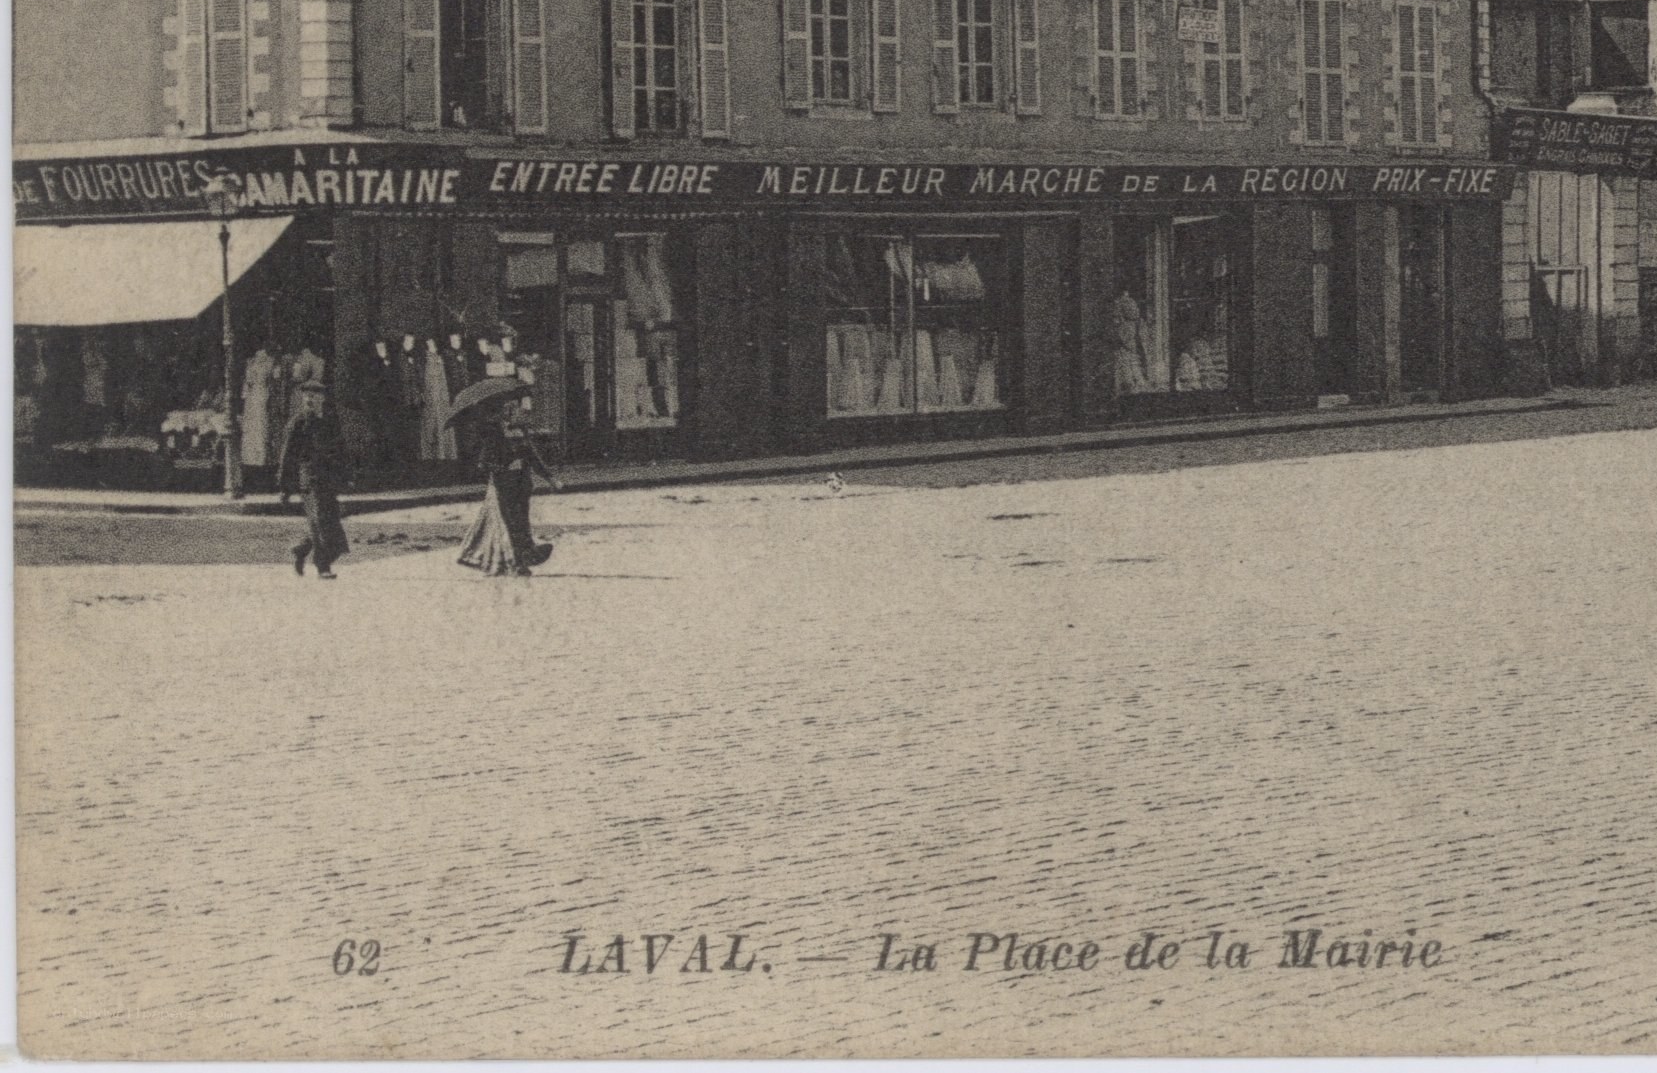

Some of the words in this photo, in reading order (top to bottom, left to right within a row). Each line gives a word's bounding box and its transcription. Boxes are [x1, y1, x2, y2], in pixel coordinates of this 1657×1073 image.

[329, 147, 360, 165] LA
[39, 160, 209, 203] FOURRURES
[489, 159, 620, 194] ENTRÉE
[627, 164, 719, 194] LIBRE
[757, 166, 947, 196] MEILLEUR
[1122, 174, 1160, 194] DE
[1183, 174, 1218, 194] LA
[1372, 167, 1497, 195] PRIX-FIXE
